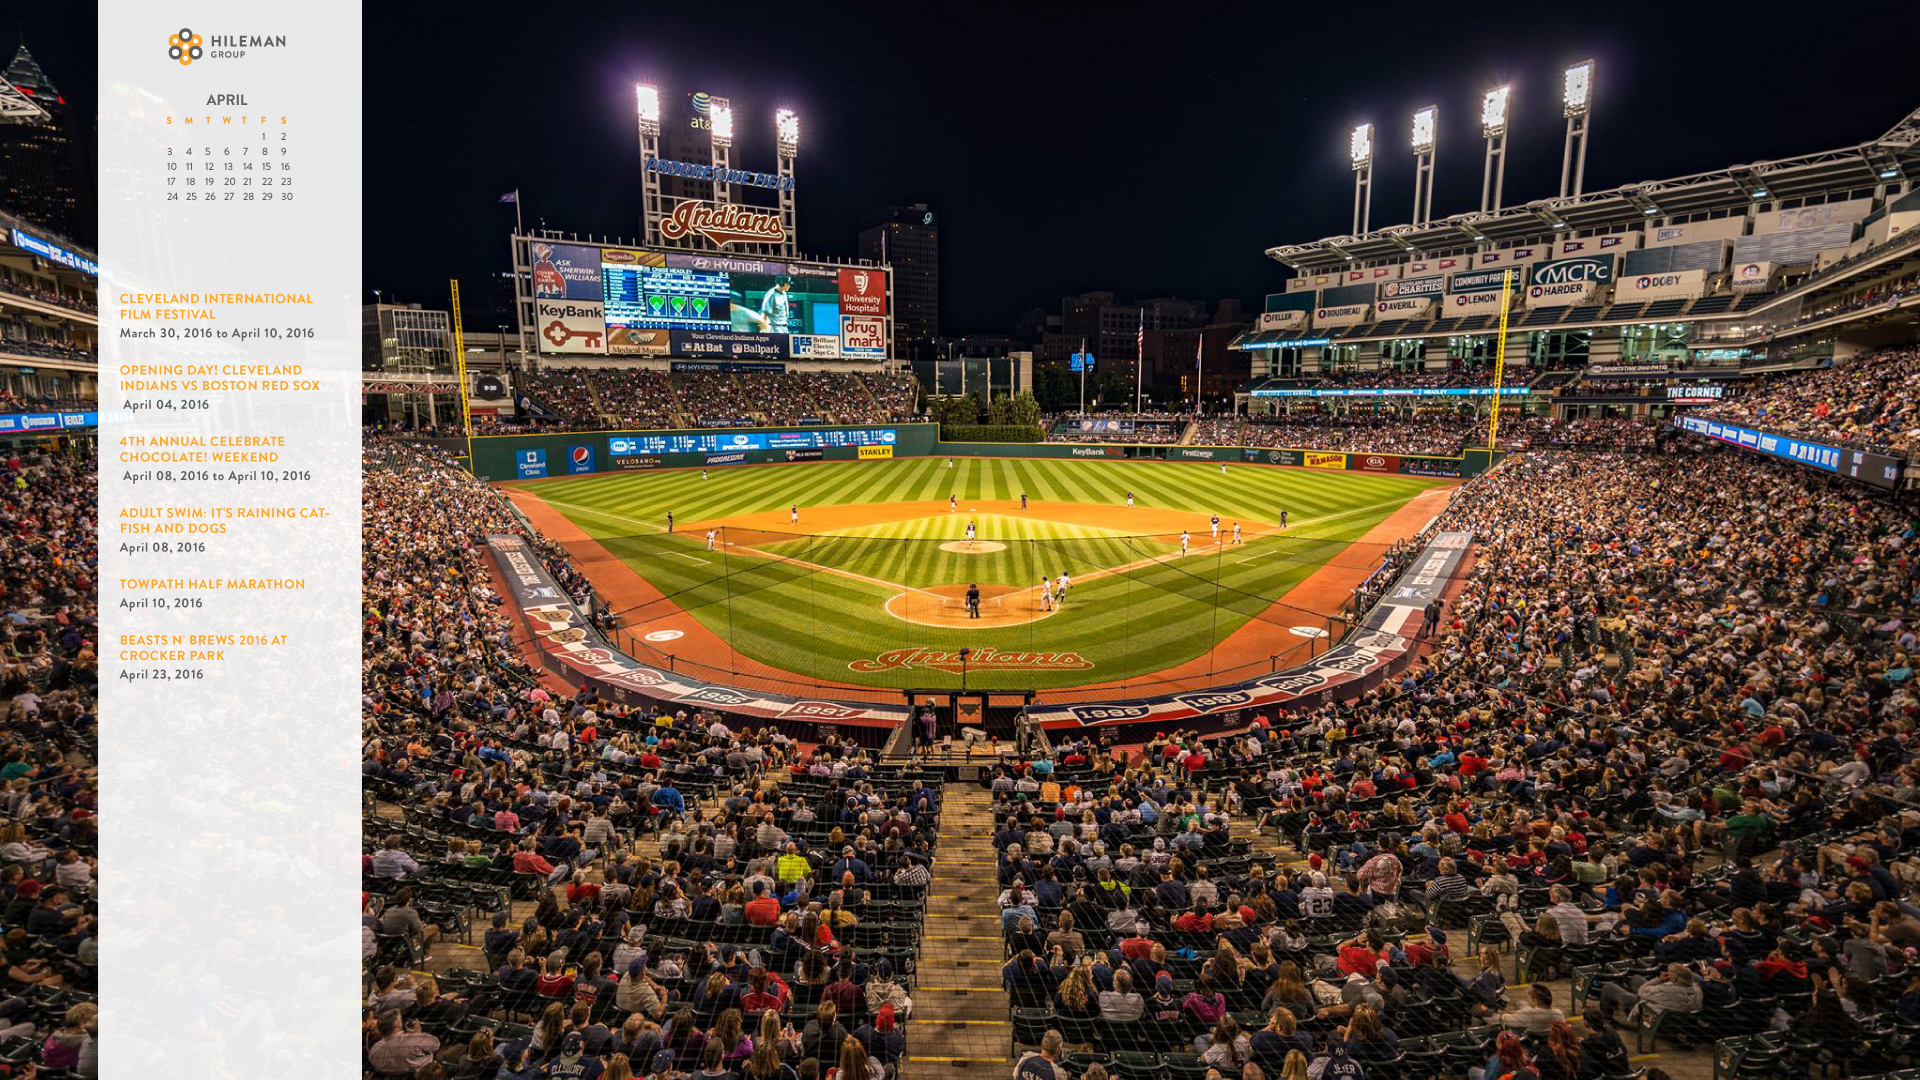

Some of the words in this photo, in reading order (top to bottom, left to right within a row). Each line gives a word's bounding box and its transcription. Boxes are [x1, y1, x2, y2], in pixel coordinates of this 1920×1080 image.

[690, 117, 712, 130] at&
[645, 157, 751, 185] PROGRESSIVE
[753, 172, 796, 191] FIELD
[660, 199, 786, 247] Indians
[559, 267, 595, 275] SHERWIN
[713, 260, 764, 273] HYUNDAI
[564, 274, 601, 283] WILLIAMS
[1455, 274, 1488, 287] COMMUNITY
[1652, 275, 1682, 287] DOBY
[1399, 282, 1443, 295] CHARITIES
[1544, 284, 1583, 295] HARDER
[843, 294, 881, 305] University
[1468, 294, 1496, 304] LEMON
[845, 303, 880, 313] Hospitals
[1388, 300, 1417, 310] AVERILL
[540, 304, 603, 319] KeyBank
[1271, 313, 1292, 321] FELLER
[1327, 307, 1361, 317] BOUDREAU
[845, 317, 877, 337] drug
[849, 334, 884, 347] mart
[612, 345, 641, 354] Medical
[693, 343, 705, 352] At
[706, 343, 724, 352] Bat
[743, 344, 780, 355] Ballpark
[1667, 387, 1683, 398] THE
[1685, 387, 1722, 398] CORNER
[1072, 448, 1105, 456] KeyBank
[707, 453, 745, 464] PROGRESSIVE
[520, 462, 545, 470] Cleveland
[848, 647, 1095, 674] Indians
[693, 689, 743, 705] 1996
[800, 703, 850, 717] 1997
[1078, 707, 1142, 719] 1998
[1312, 899, 1332, 913] 23
